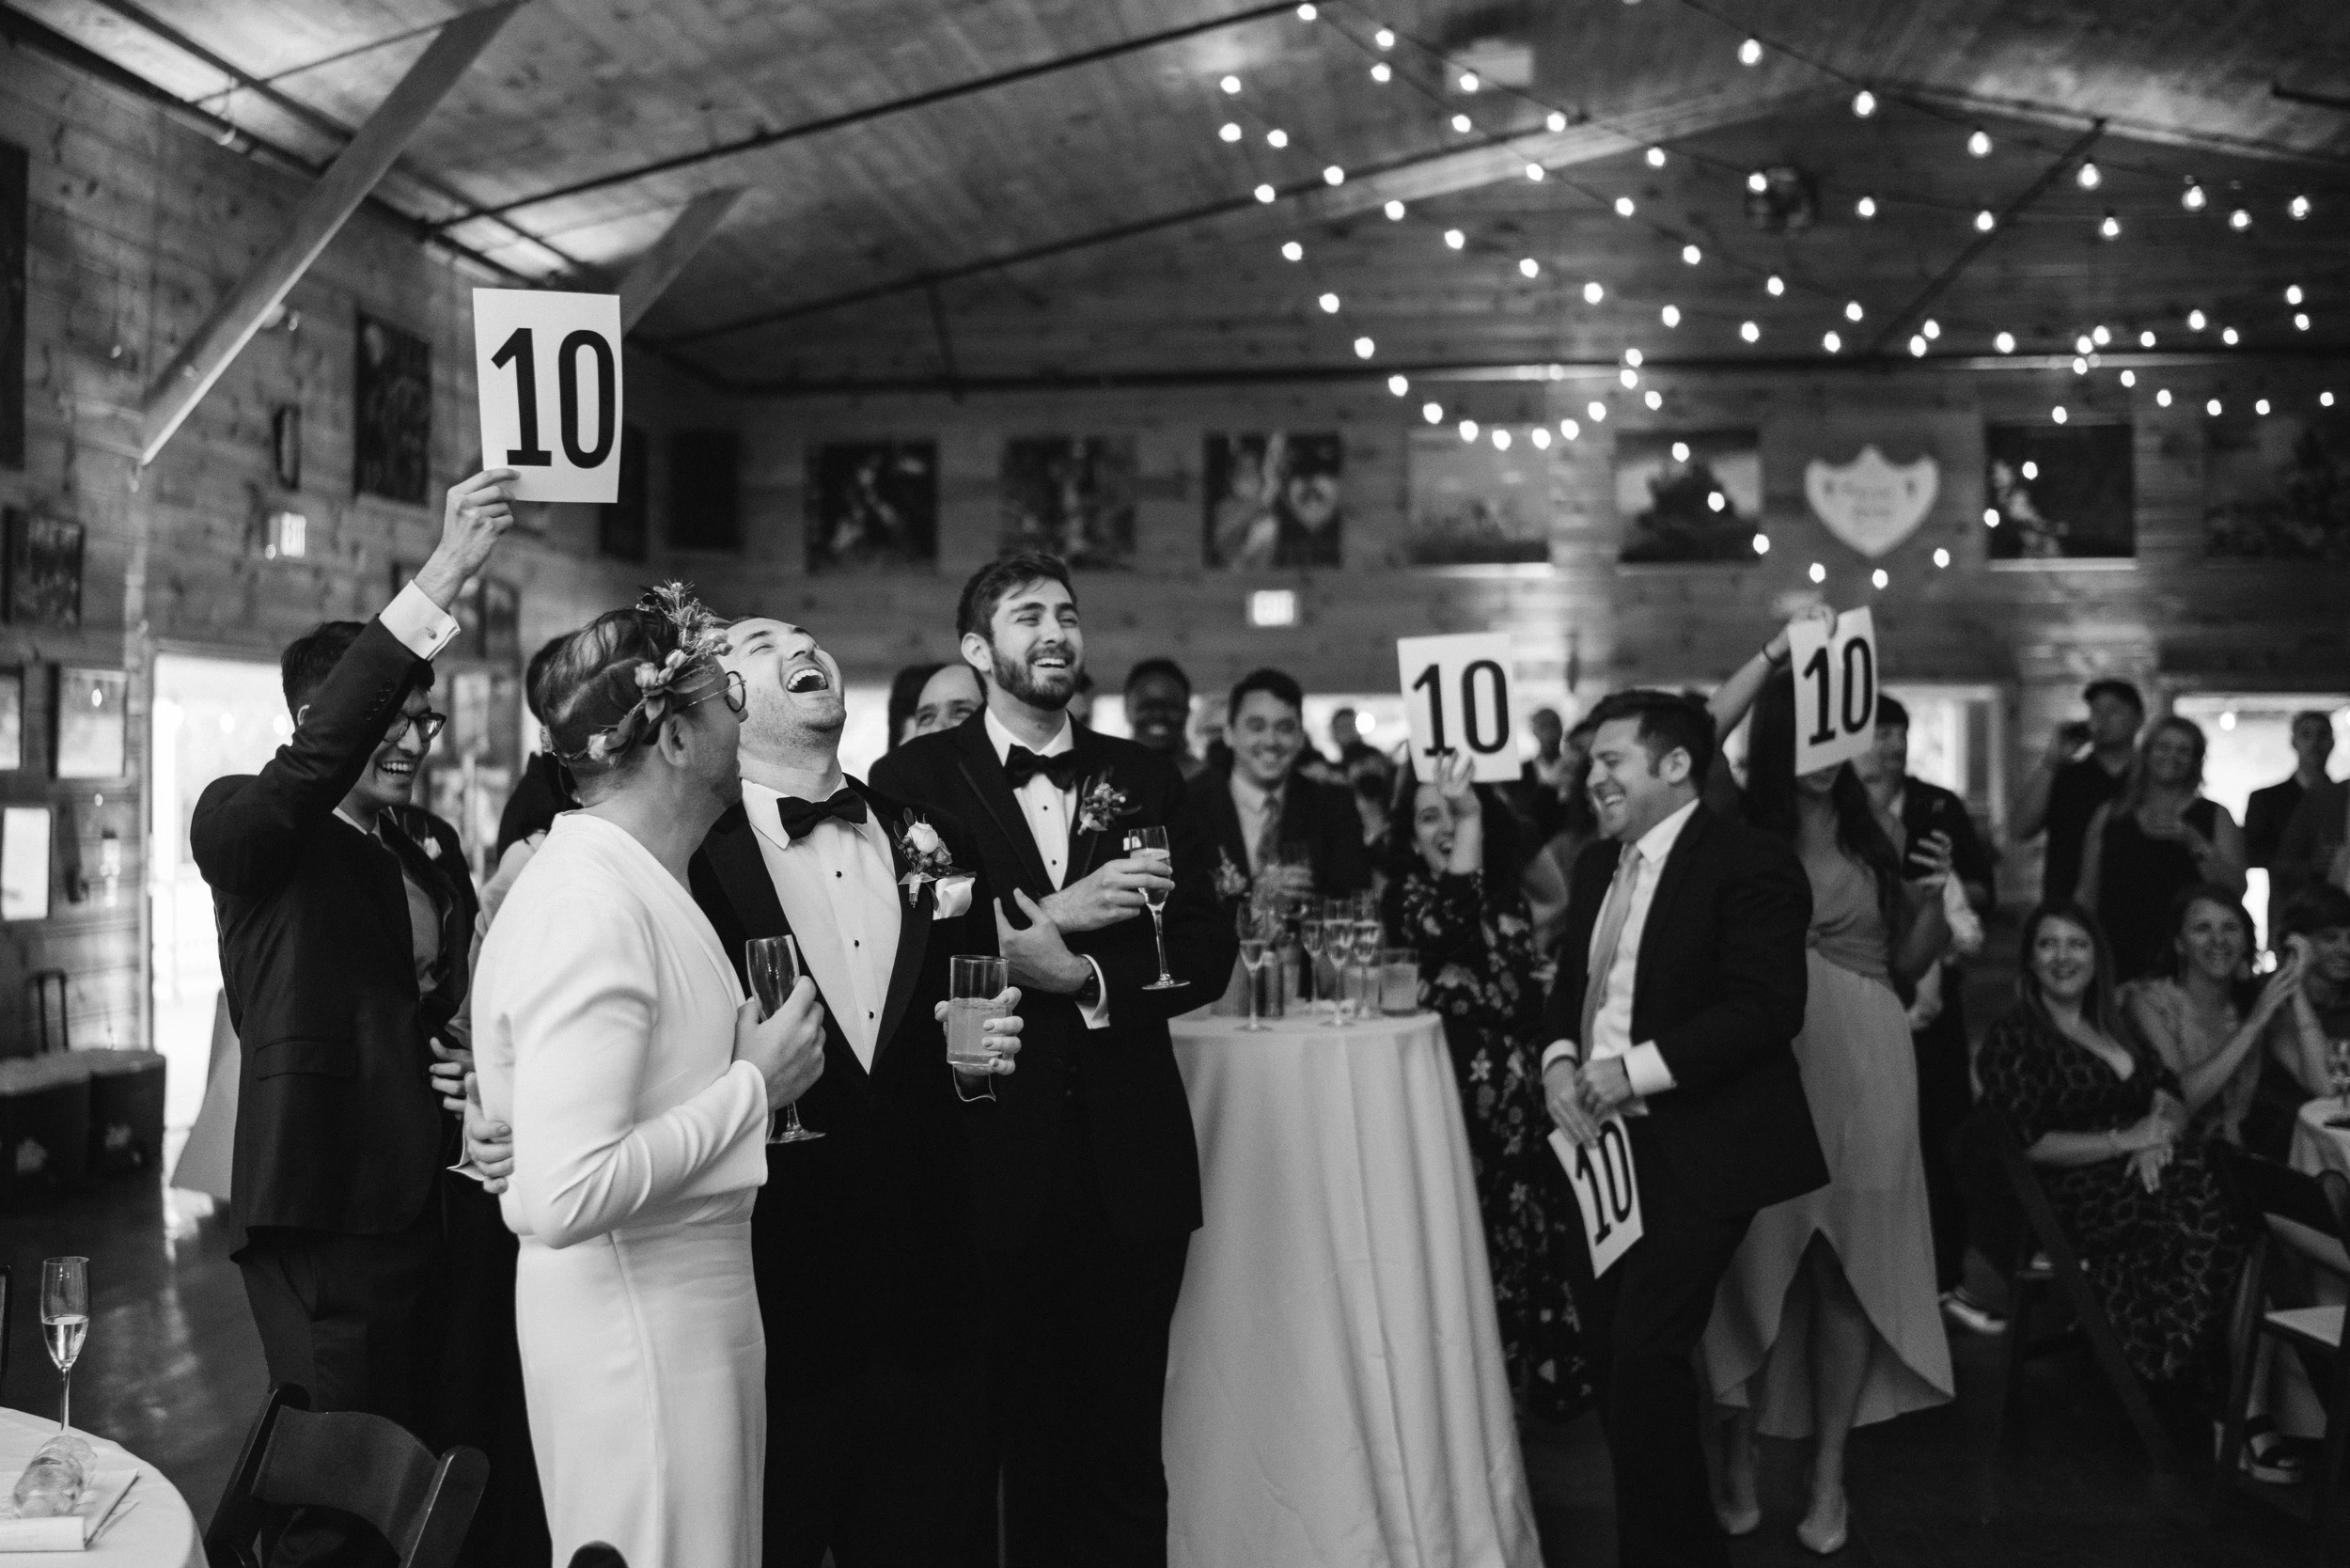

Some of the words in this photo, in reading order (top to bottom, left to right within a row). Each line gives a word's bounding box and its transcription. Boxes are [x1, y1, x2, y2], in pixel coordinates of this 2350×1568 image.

[491, 327, 616, 469] 10
[1413, 660, 1510, 757] 10
[1802, 636, 1872, 746] 10
[1576, 1120, 1632, 1247] 10
